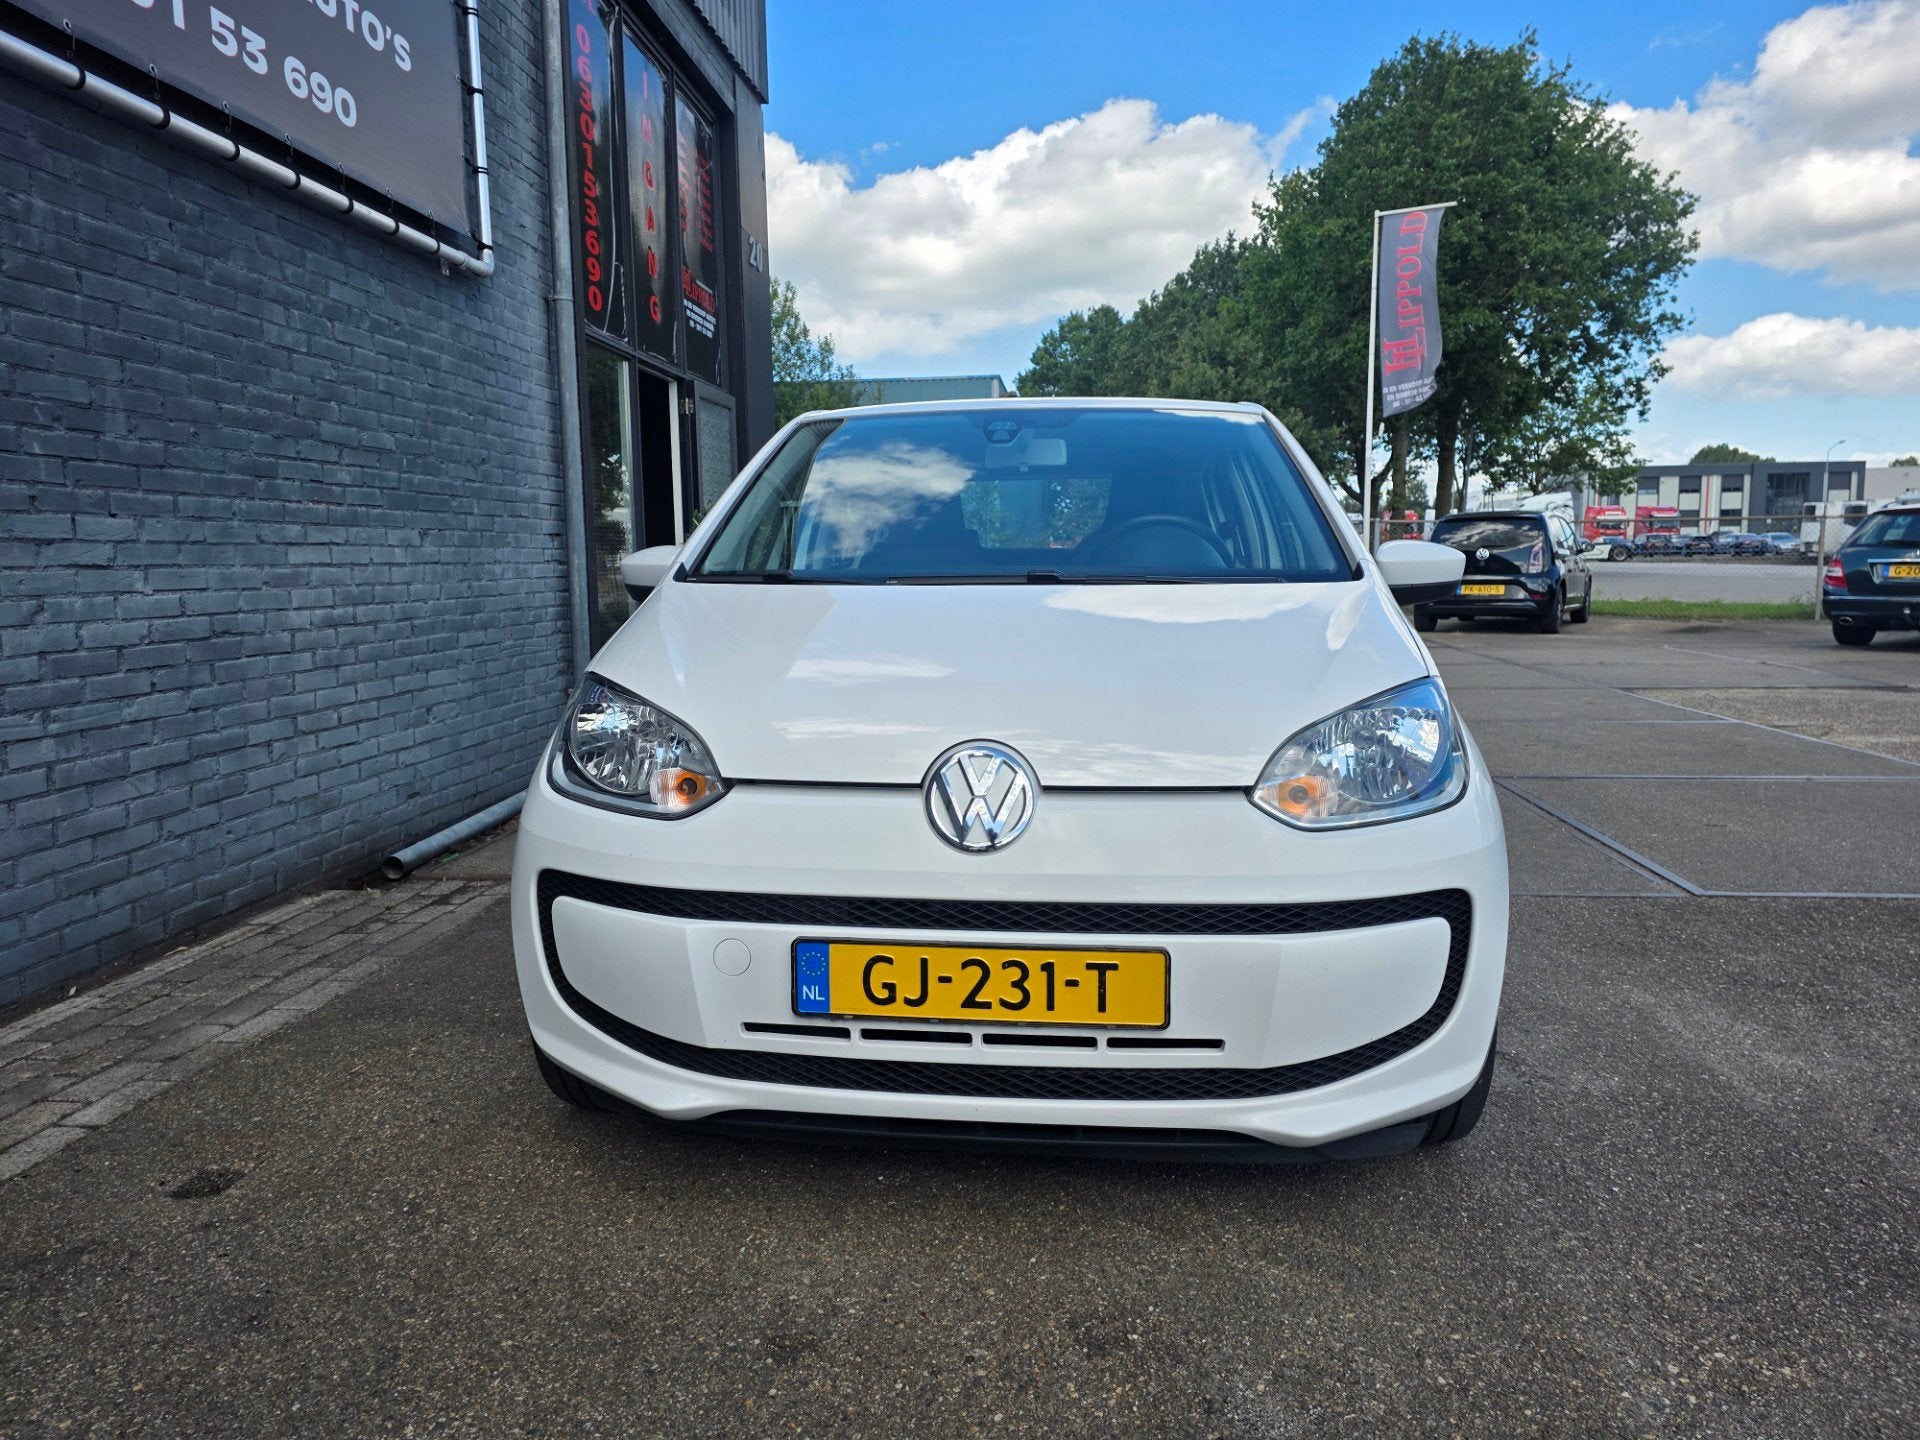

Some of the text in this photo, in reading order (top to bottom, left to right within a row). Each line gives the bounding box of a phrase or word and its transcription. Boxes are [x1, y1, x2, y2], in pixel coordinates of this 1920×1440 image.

[210, 6, 269, 75] 53
[284, 56, 357, 128] 690
[641, 70, 661, 323] INGANG
[749, 235, 763, 272] 20
[930, 748, 1036, 851] VW
[802, 985, 825, 1001] NL
[861, 953, 1121, 1014] GJ-231-T
